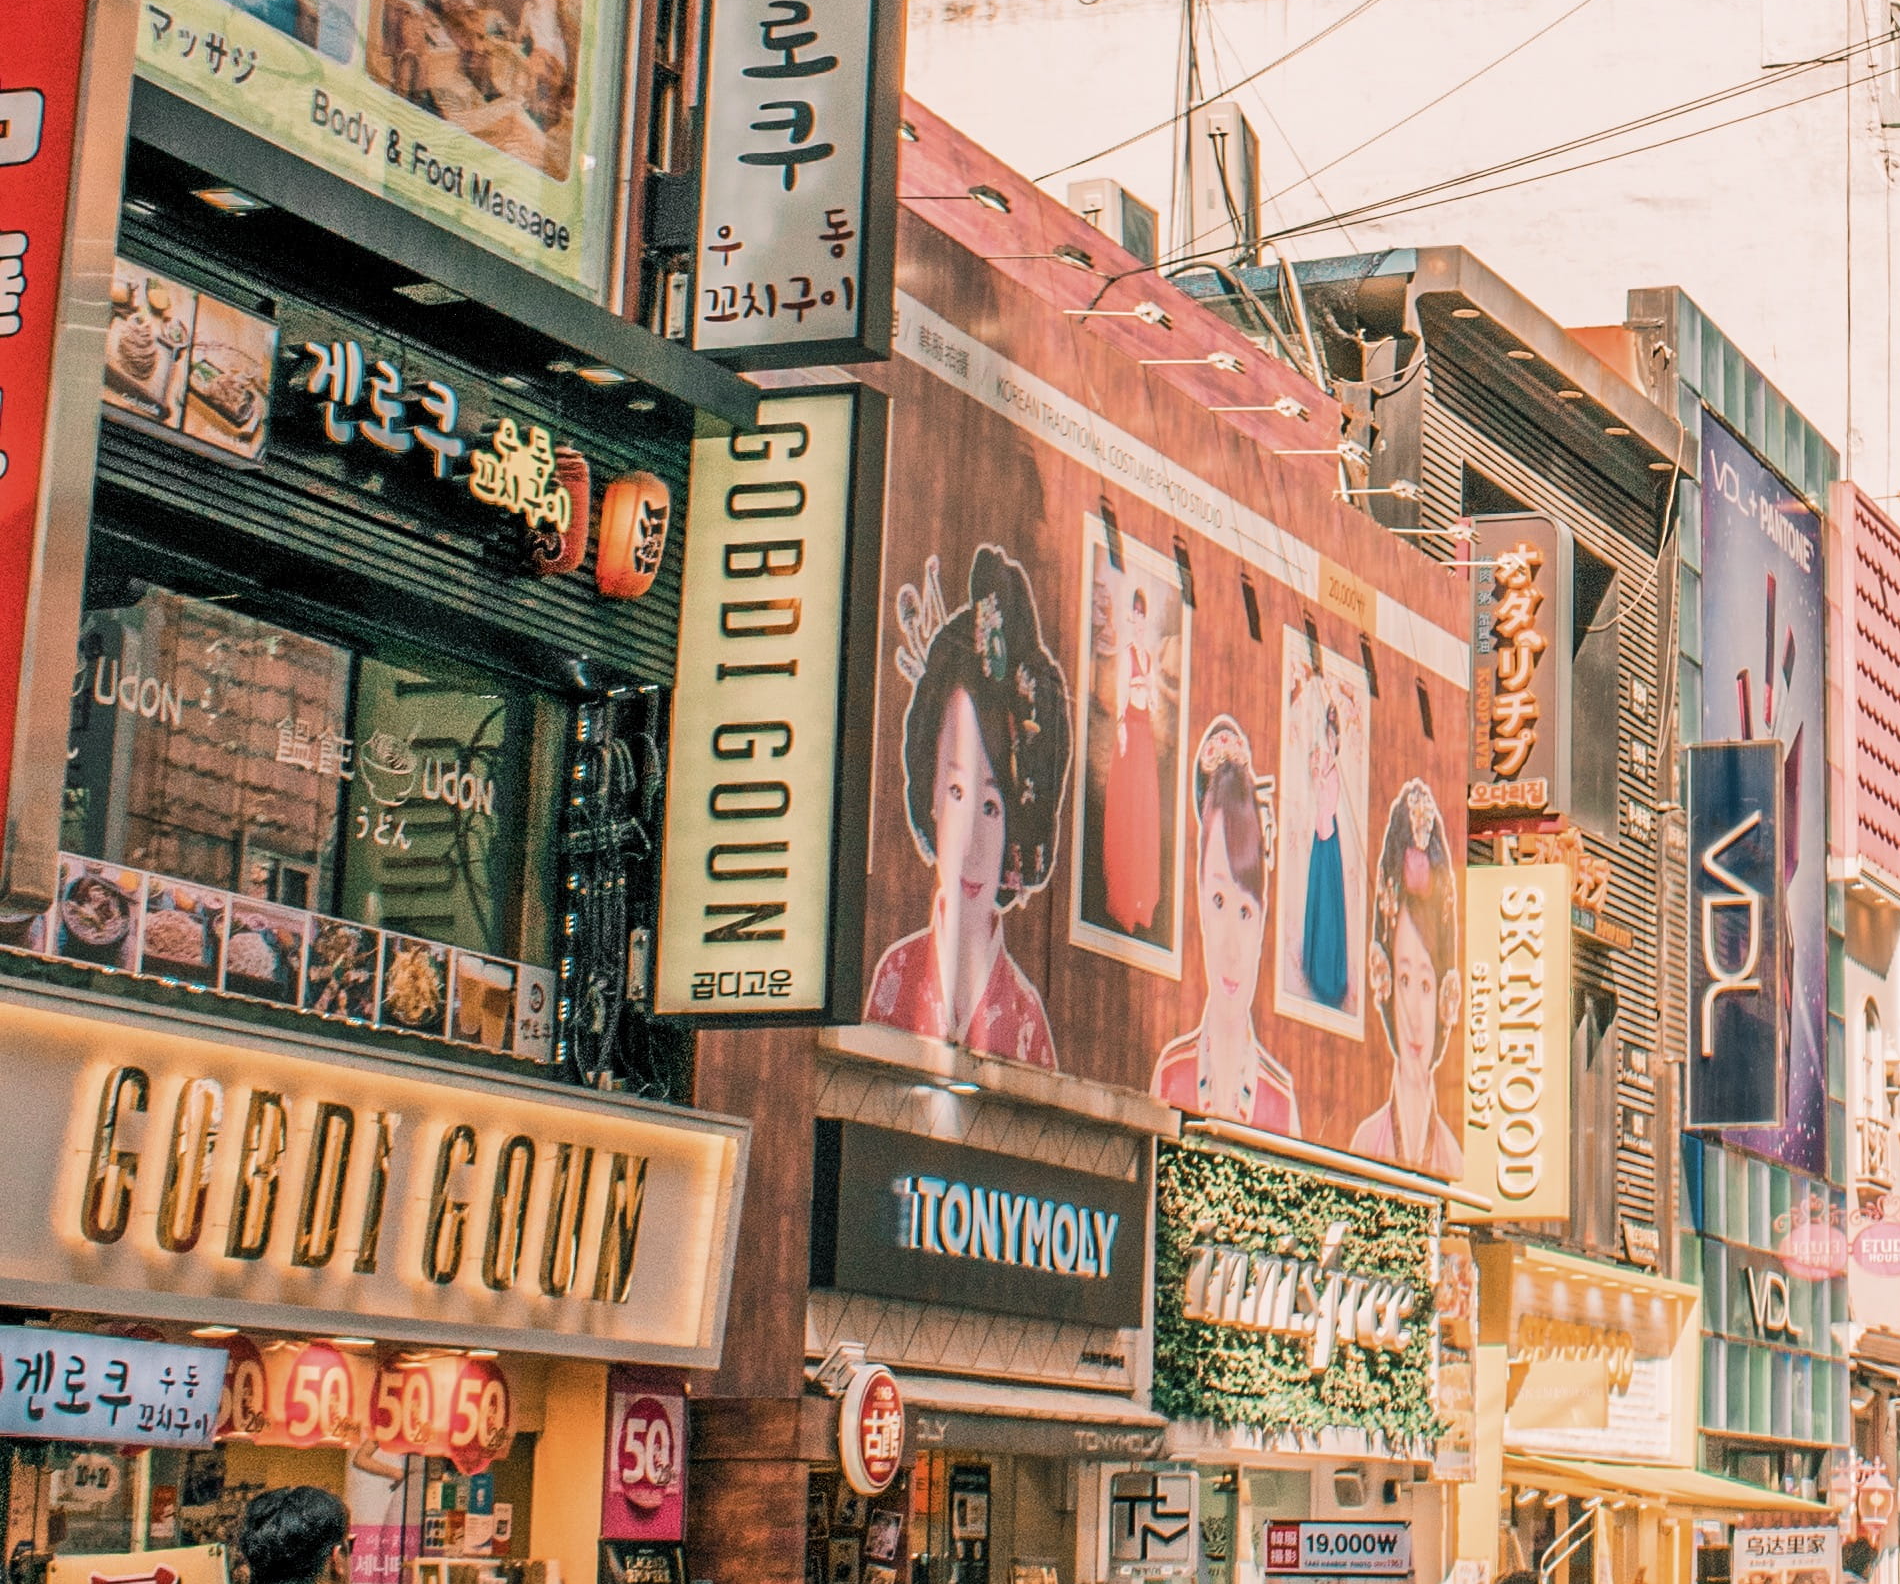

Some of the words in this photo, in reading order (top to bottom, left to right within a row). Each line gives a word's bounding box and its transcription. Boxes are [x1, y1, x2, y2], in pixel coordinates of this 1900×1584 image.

[310, 88, 378, 160] Body
[385, 127, 405, 167] &
[411, 142, 465, 201] Foot
[473, 174, 572, 254] Massage
[703, 274, 857, 324] 꼬치구이
[303, 339, 468, 478] 겐로쿠
[716, 421, 811, 684] GOBDI
[1709, 449, 1750, 519] VDL
[1759, 495, 1814, 575] PANTONE
[701, 721, 794, 946] GOUN
[1472, 780, 1545, 806] 오다리집
[1700, 811, 1763, 1059] VDL
[692, 969, 793, 1002] 곱디고운
[1469, 960, 1491, 1049] since
[1496, 886, 1546, 1200] SKINFOOD
[81, 1065, 401, 1274] GOBDI
[421, 1123, 650, 1303] GOUN
[911, 1175, 1119, 1279] TONYMOLY
[1747, 1266, 1804, 1339] VDL
[15, 1348, 131, 1425] 겐로쿠
[289, 1364, 350, 1438] 50
[375, 1371, 431, 1443] 50
[451, 1377, 507, 1448] 50
[622, 1418, 670, 1485] 50
[1745, 1534, 1826, 1556] 乌达里家
